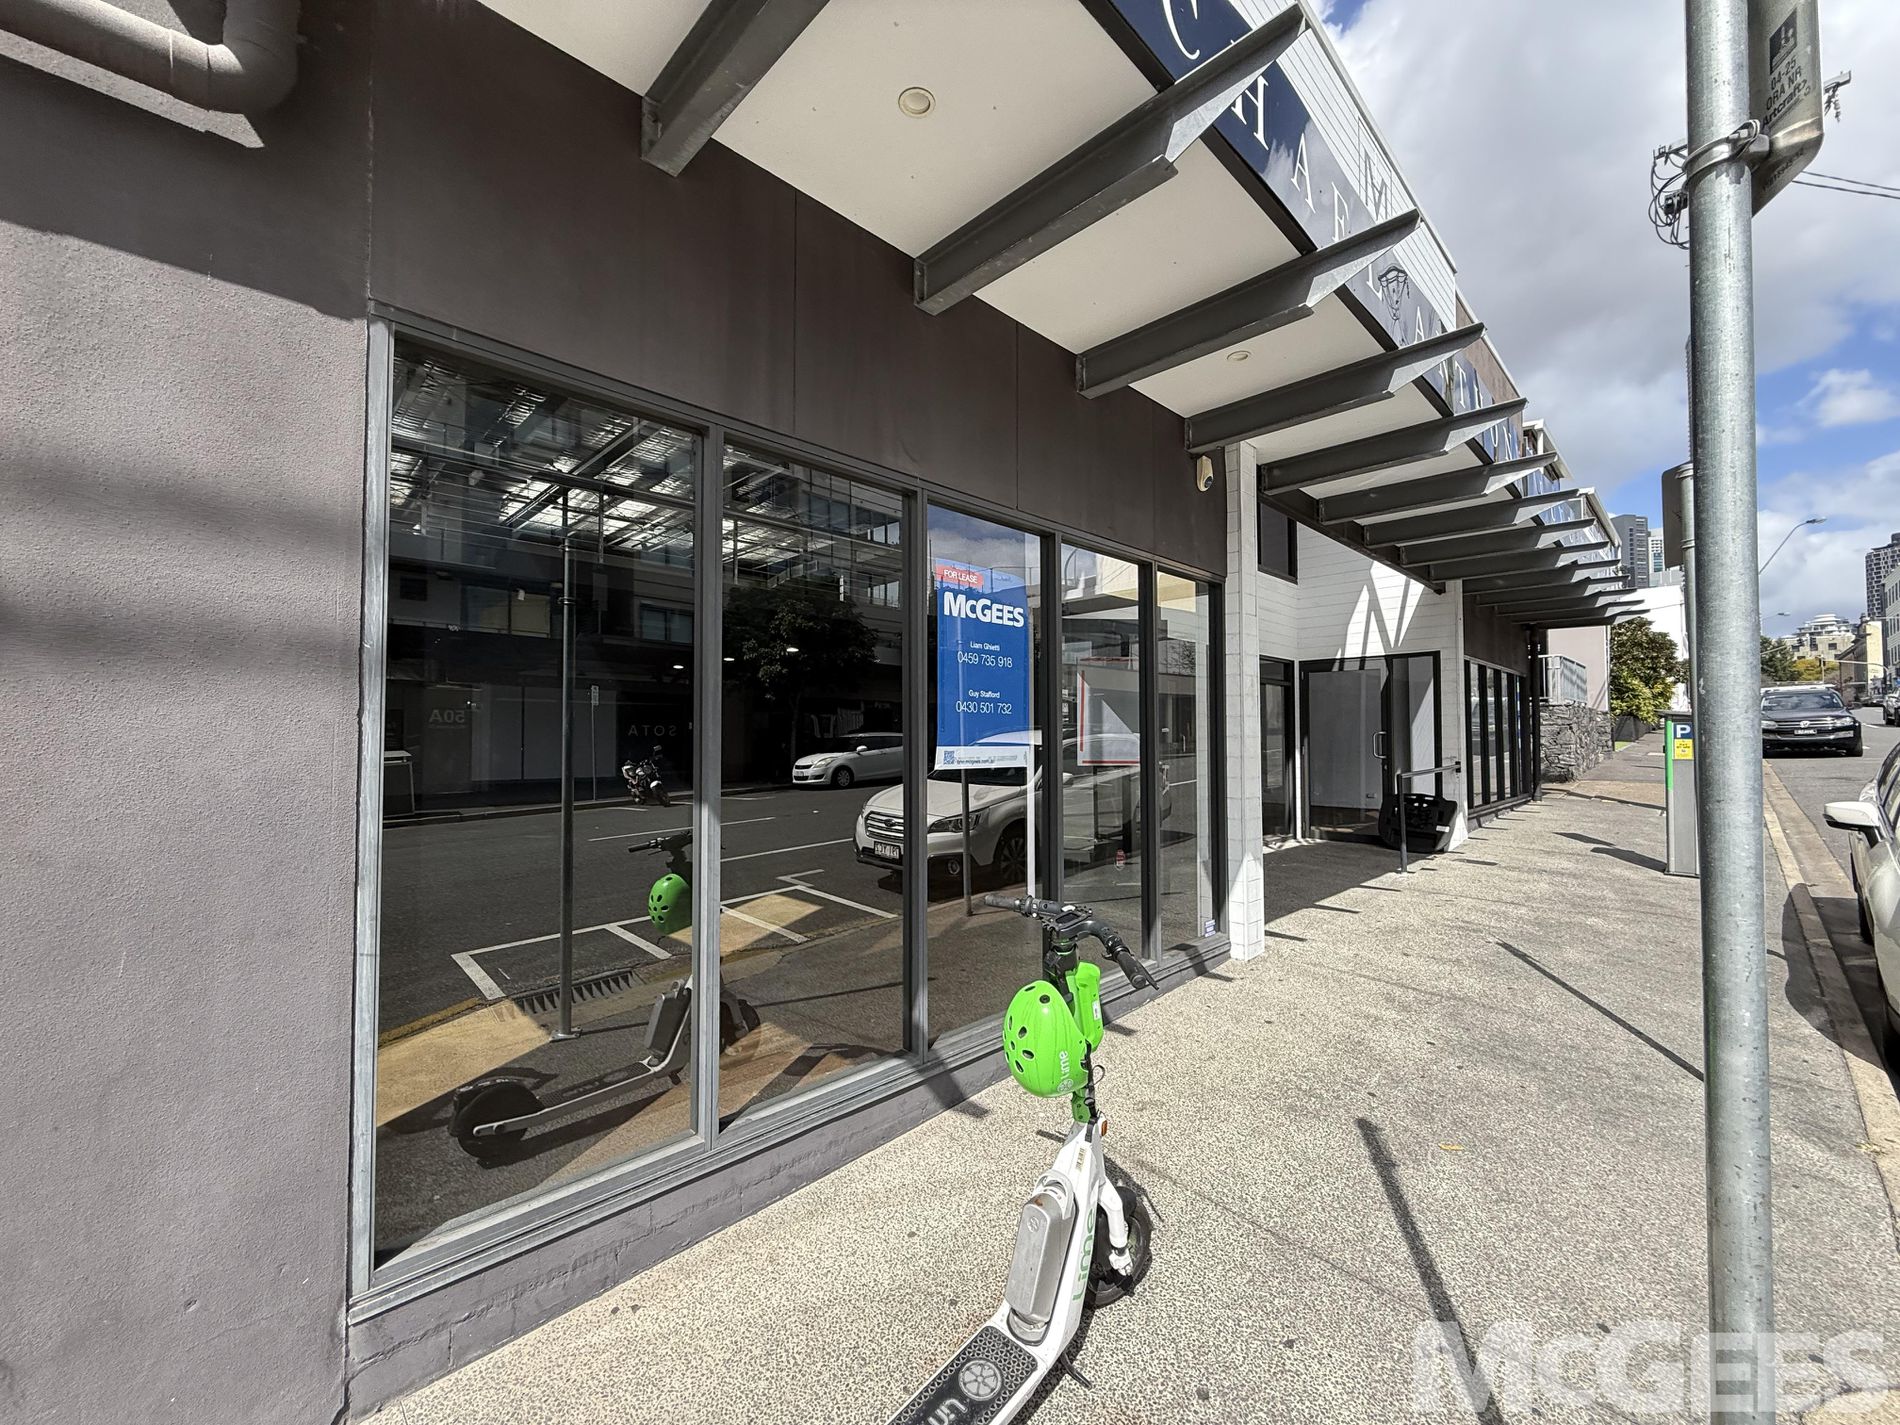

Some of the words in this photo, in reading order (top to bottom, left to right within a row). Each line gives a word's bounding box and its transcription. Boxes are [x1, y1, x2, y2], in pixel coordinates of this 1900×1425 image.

[943, 569, 958, 579] FOR
[958, 572, 978, 584] LEASE
[970, 641, 983, 650] Liam
[957, 651, 979, 665] 0459
[980, 654, 996, 667] 735
[997, 656, 1013, 668] 918
[968, 689, 979, 699] Guy
[979, 690, 1001, 699] Stafford
[955, 701, 978, 713] 0430
[980, 702, 994, 714] 501
[996, 703, 1012, 715] 732
[1676, 724, 1691, 738] P
[1059, 1050, 1070, 1080] Lime
